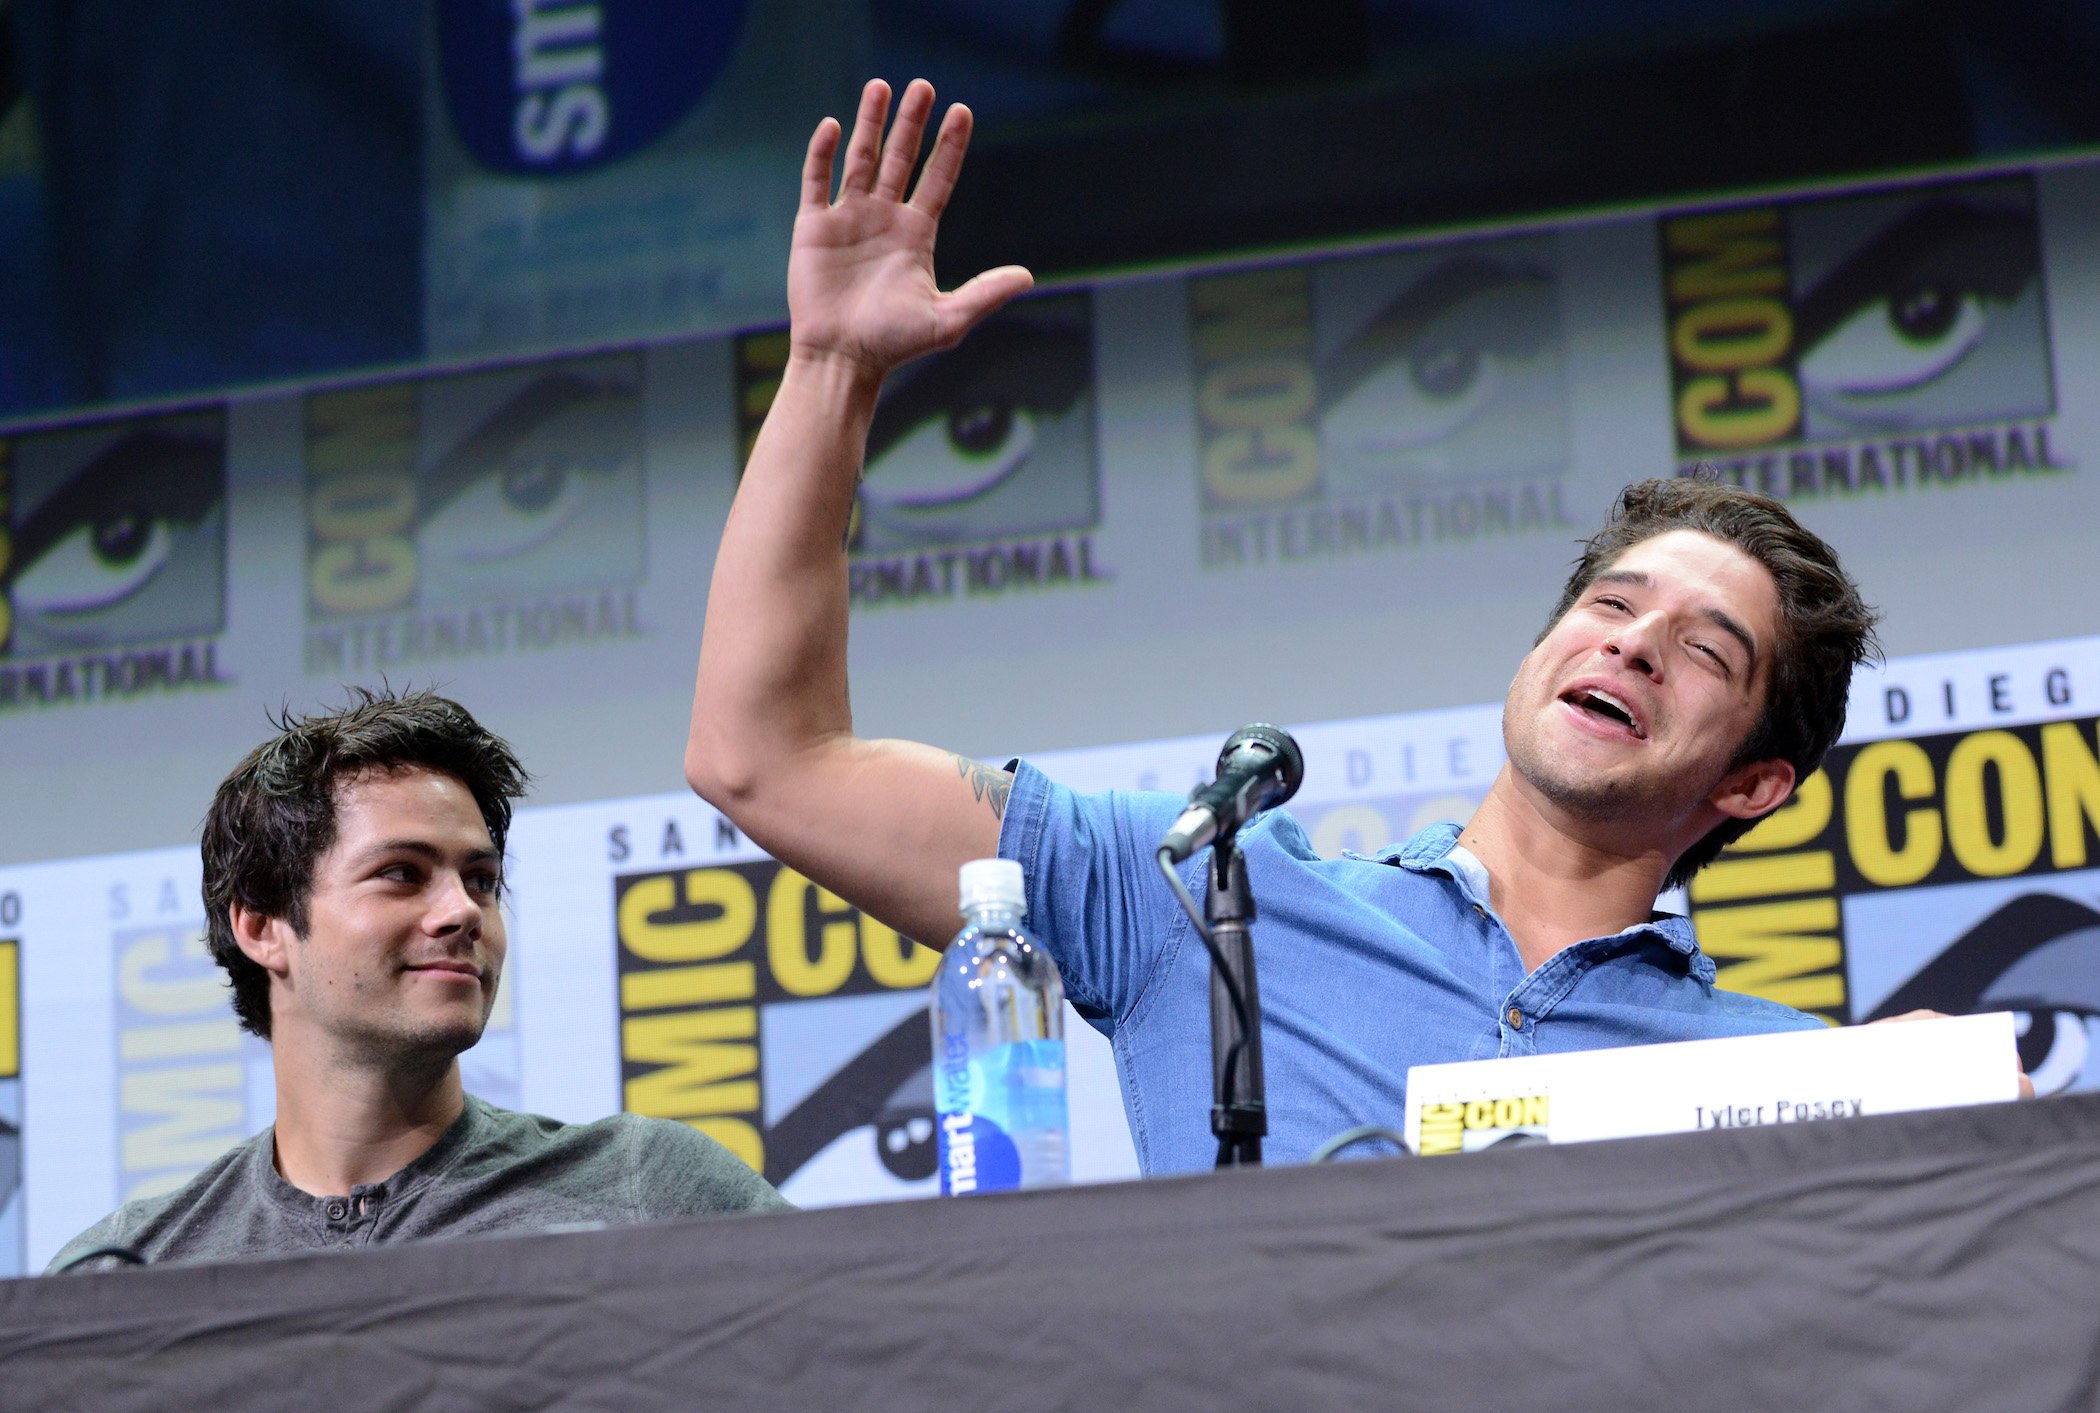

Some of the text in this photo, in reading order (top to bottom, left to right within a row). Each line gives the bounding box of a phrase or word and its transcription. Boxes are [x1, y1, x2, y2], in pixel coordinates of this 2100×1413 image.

[1668, 208, 1799, 448] COM
[1202, 480, 1570, 566] INTERNATIONAL
[303, 590, 648, 670] INTERNATIONAL
[1886, 668, 2071, 725] DIEG
[608, 815, 740, 860] SAN
[1843, 720, 2100, 888] CON
[1464, 1096, 1549, 1130] CON
[1776, 1098, 1862, 1123] Posey
